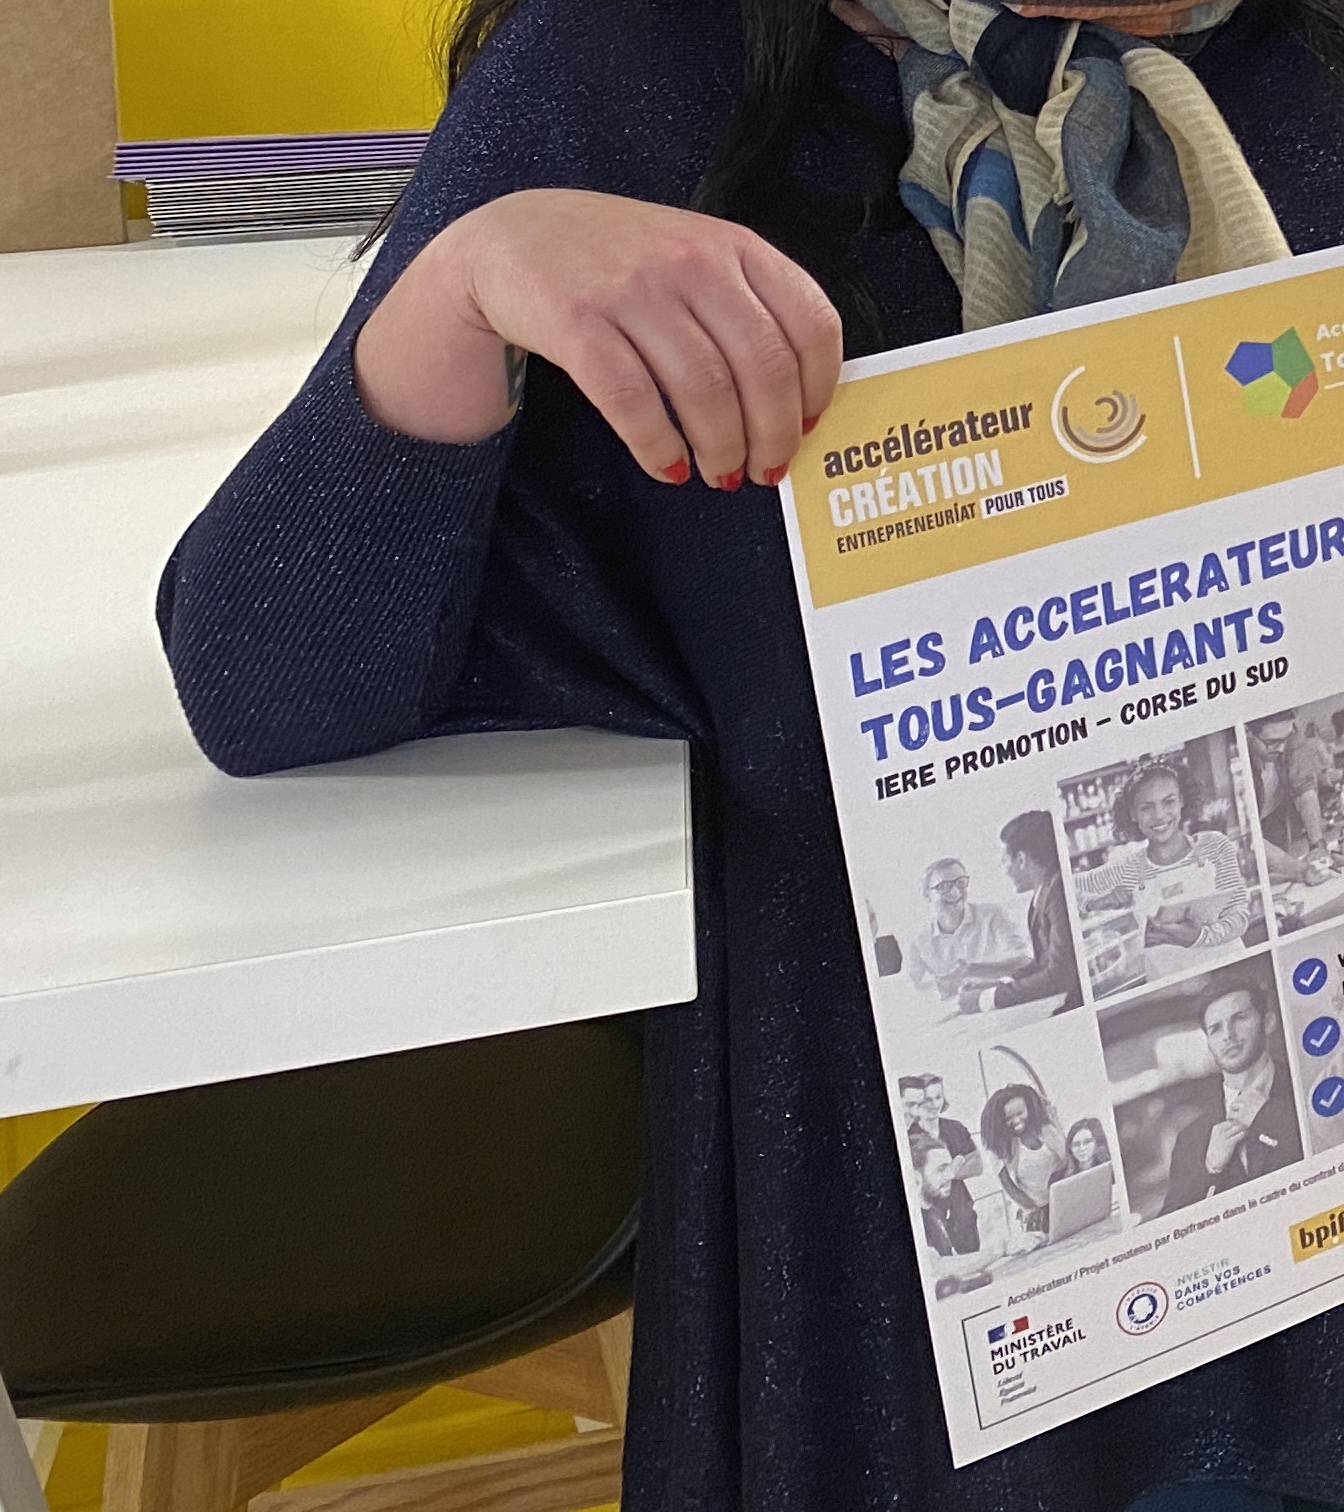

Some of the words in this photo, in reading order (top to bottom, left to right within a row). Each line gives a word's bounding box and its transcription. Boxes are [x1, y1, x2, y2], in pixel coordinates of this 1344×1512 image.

[824, 402, 1033, 478] accélérateur
[828, 448, 1004, 528] CRÉATION
[985, 490, 1024, 515] POUR
[1027, 480, 1065, 504] TOUS
[850, 632, 946, 698] LES
[945, 716, 1088, 780] PROMOTION
[1120, 683, 1198, 725] CORSE
[1206, 671, 1237, 700] DU
[1246, 656, 1289, 688] SUD
[1175, 1278, 1209, 1300] DANS
[1214, 1265, 1241, 1282] VOS
[991, 1318, 1074, 1361] MINISTÈRE
[993, 1357, 1016, 1375] DU
[1020, 1329, 1086, 1363] TRAVAIL
